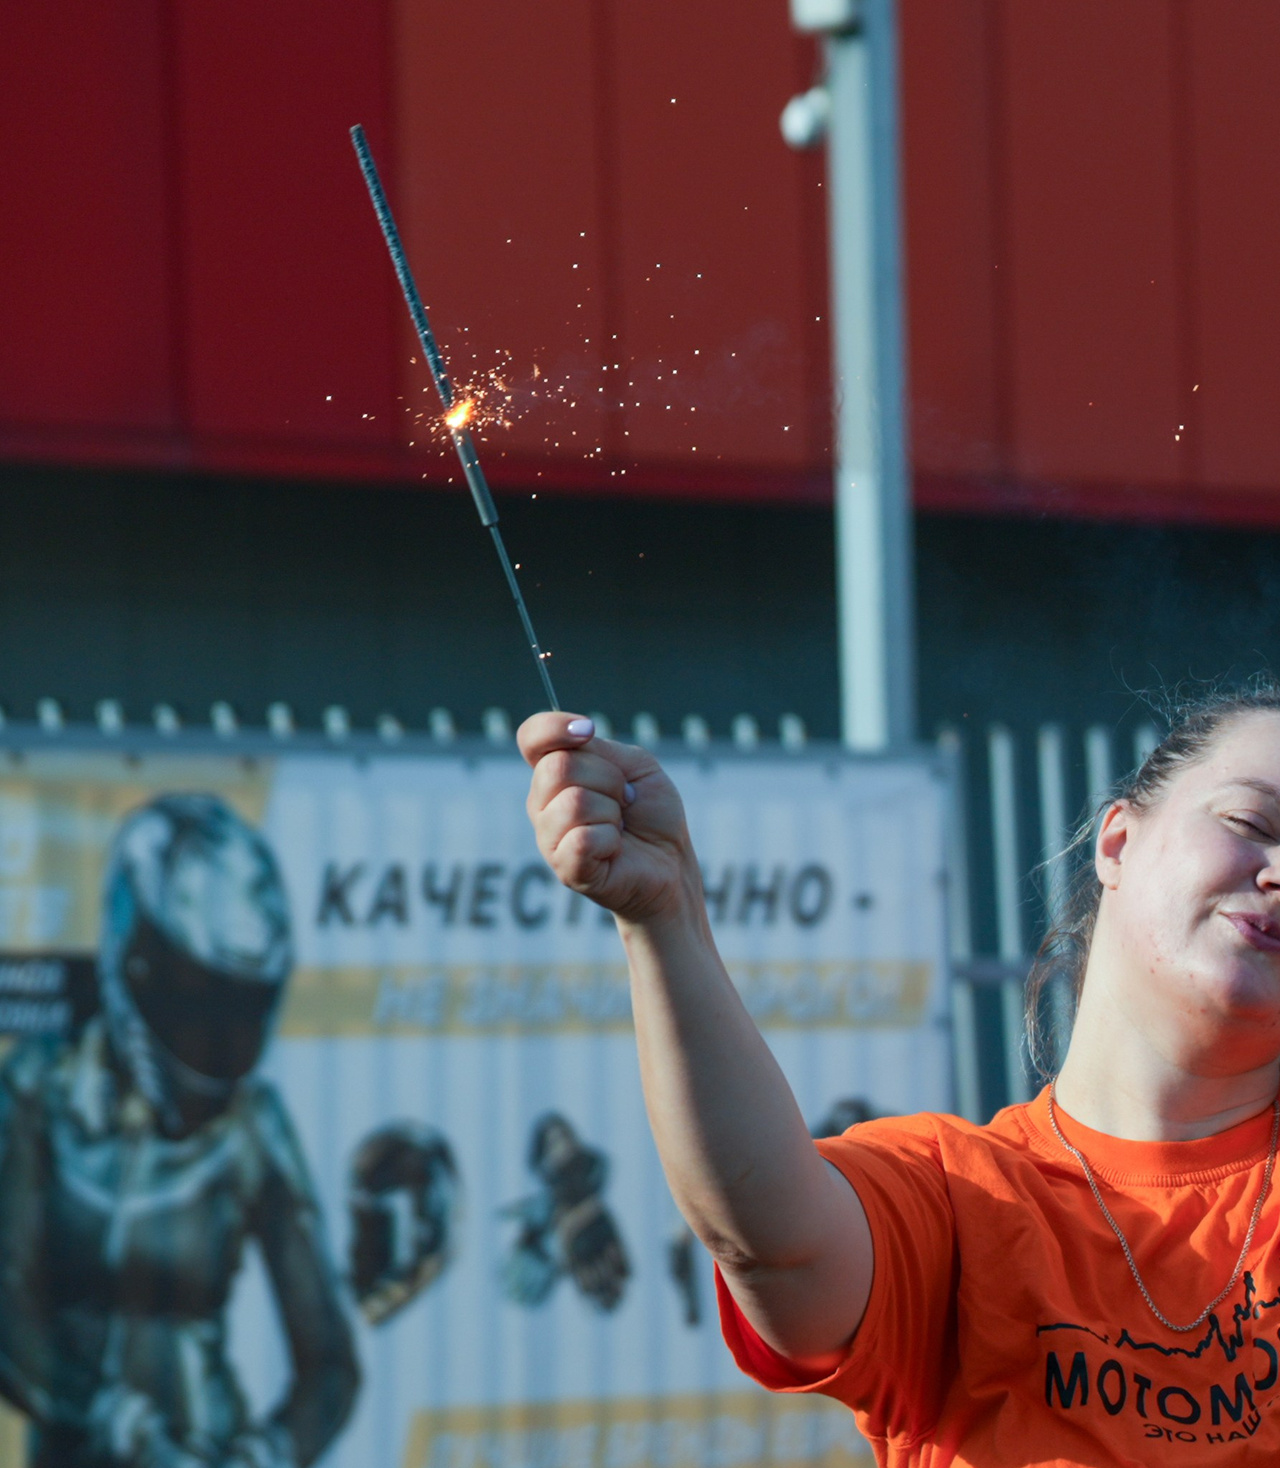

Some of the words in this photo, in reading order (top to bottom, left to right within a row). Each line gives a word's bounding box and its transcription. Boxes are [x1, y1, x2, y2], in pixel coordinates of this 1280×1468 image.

[316, 860, 834, 928] КАЧЕСННО
[1143, 1423, 1197, 1442] ЭТО
[1206, 1409, 1262, 1444] НАШ
